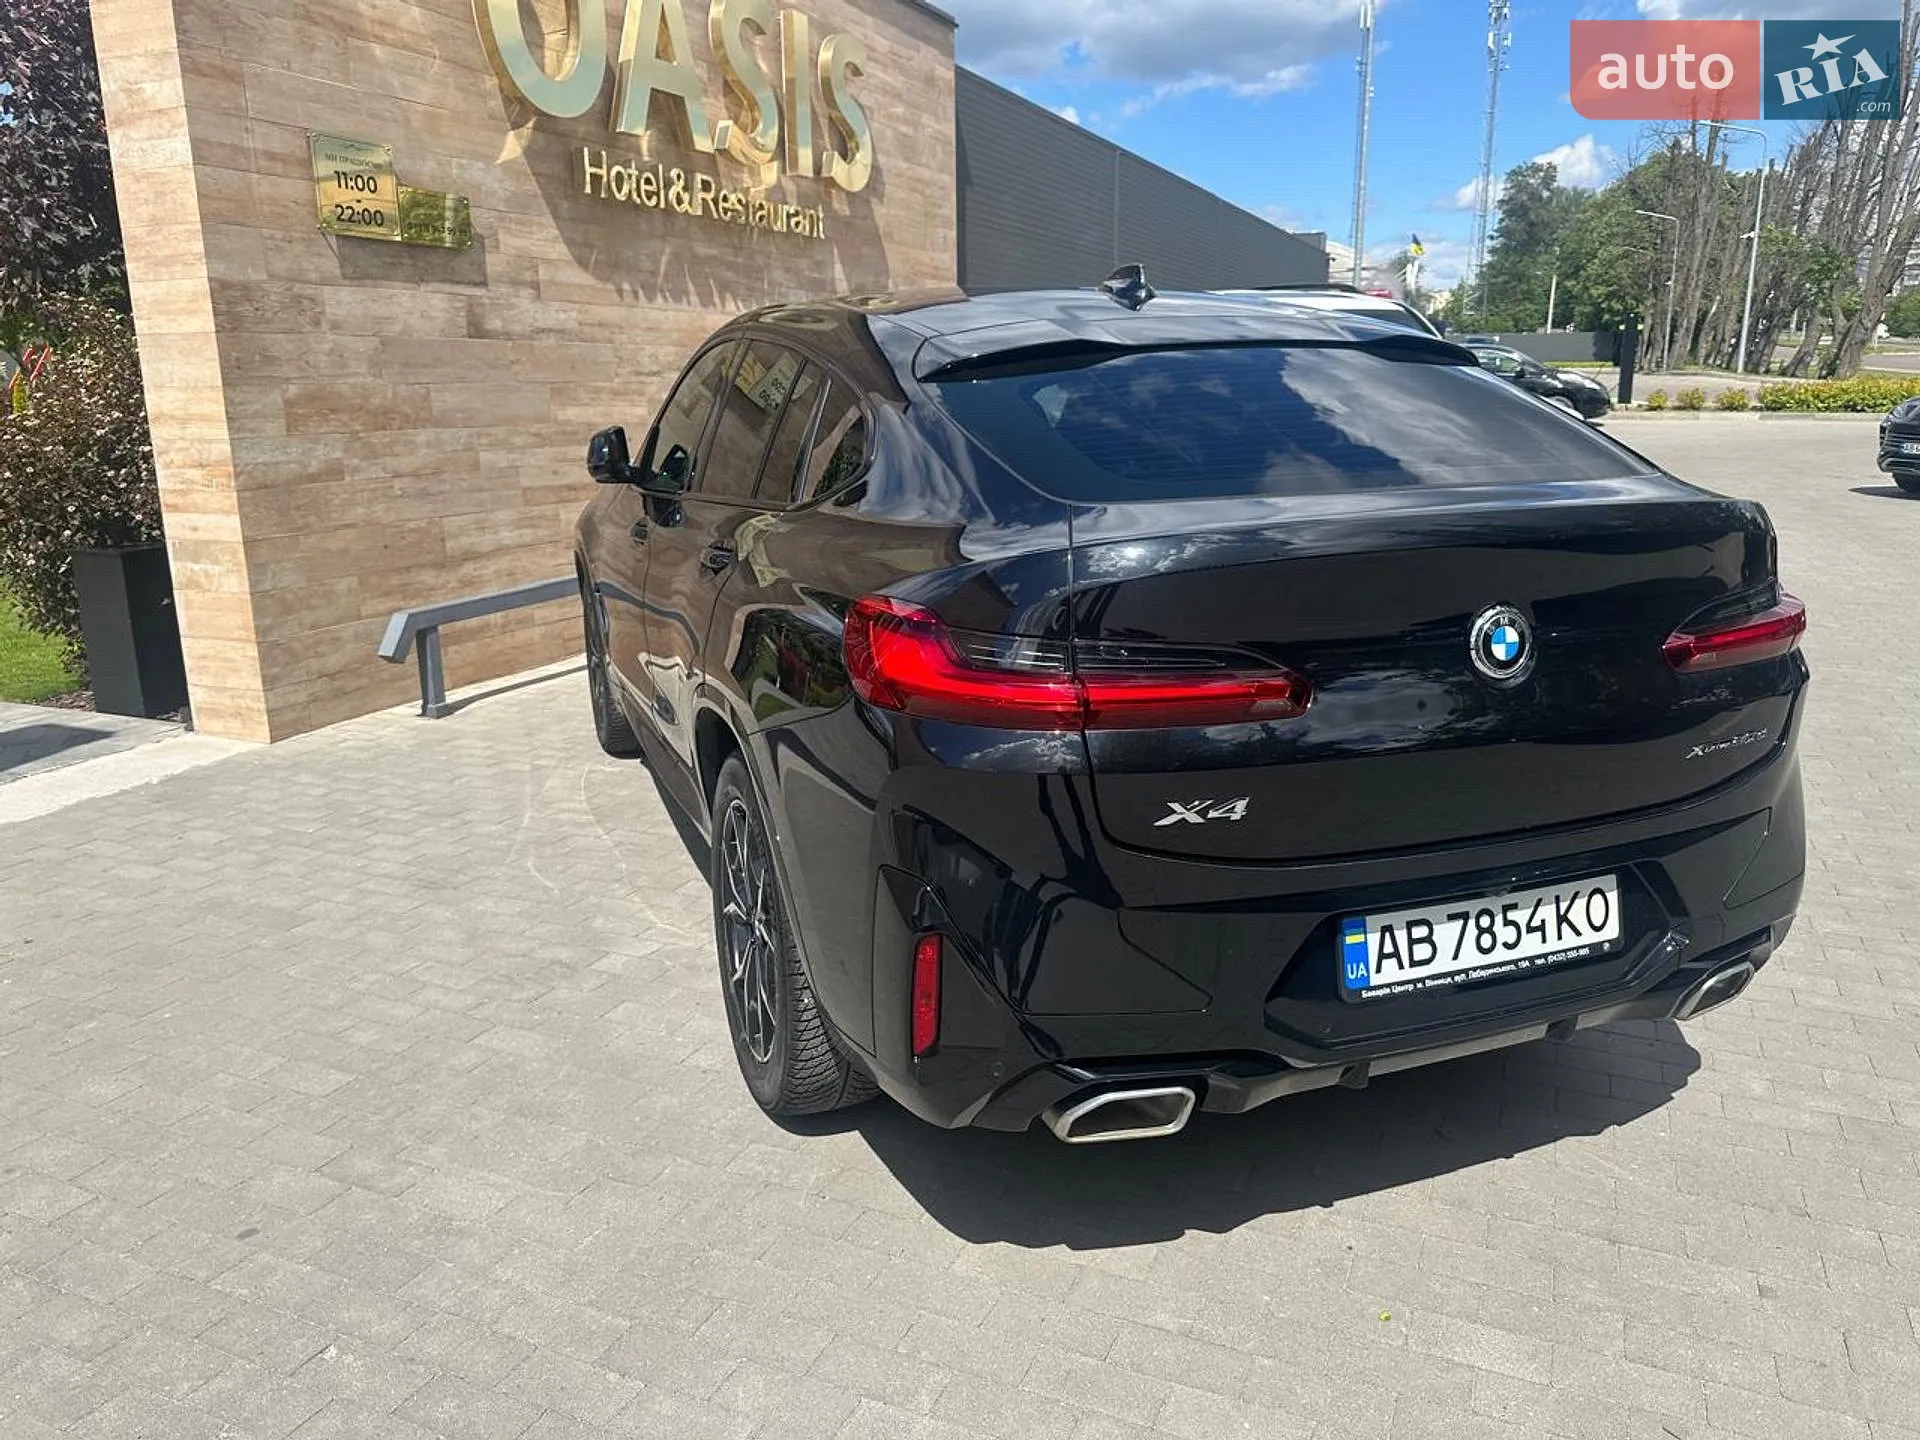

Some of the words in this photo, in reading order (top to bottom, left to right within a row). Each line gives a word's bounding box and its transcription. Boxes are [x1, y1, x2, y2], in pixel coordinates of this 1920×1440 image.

[472, 0, 873, 193] OASIS
[333, 170, 378, 194] 11:00
[334, 203, 385, 227] 22:00
[1153, 797, 1250, 826] X4
[1347, 962, 1368, 980] UA
